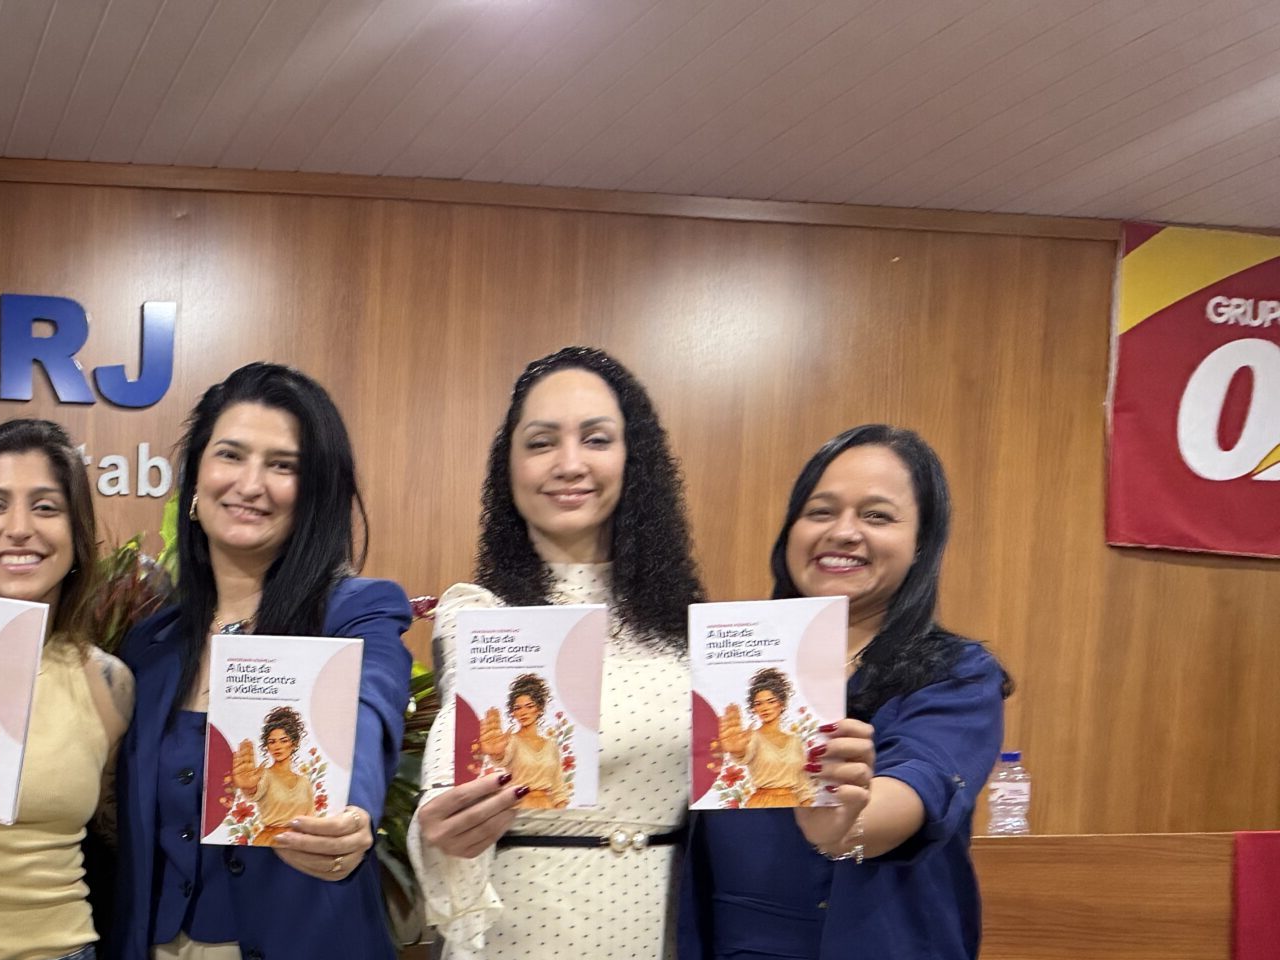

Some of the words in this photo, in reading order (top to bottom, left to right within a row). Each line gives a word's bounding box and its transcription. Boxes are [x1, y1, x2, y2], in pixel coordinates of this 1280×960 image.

[706, 630, 715, 638] A
[716, 629, 739, 638] luta
[739, 628, 754, 637] da
[470, 635, 478, 644] A
[482, 635, 500, 644] luta
[502, 634, 515, 643] da
[706, 639, 744, 649] mulher
[745, 638, 781, 647] contra
[470, 645, 506, 654] mulher
[508, 644, 541, 653] contra
[716, 649, 762, 659] violência
[470, 656, 477, 664] a
[479, 654, 523, 664] violência
[226, 663, 235, 673] A
[236, 663, 256, 674] luta
[257, 664, 271, 674] da
[226, 674, 261, 684] mulher
[263, 675, 296, 685] contra
[225, 686, 231, 694] a
[234, 684, 279, 695] violência
